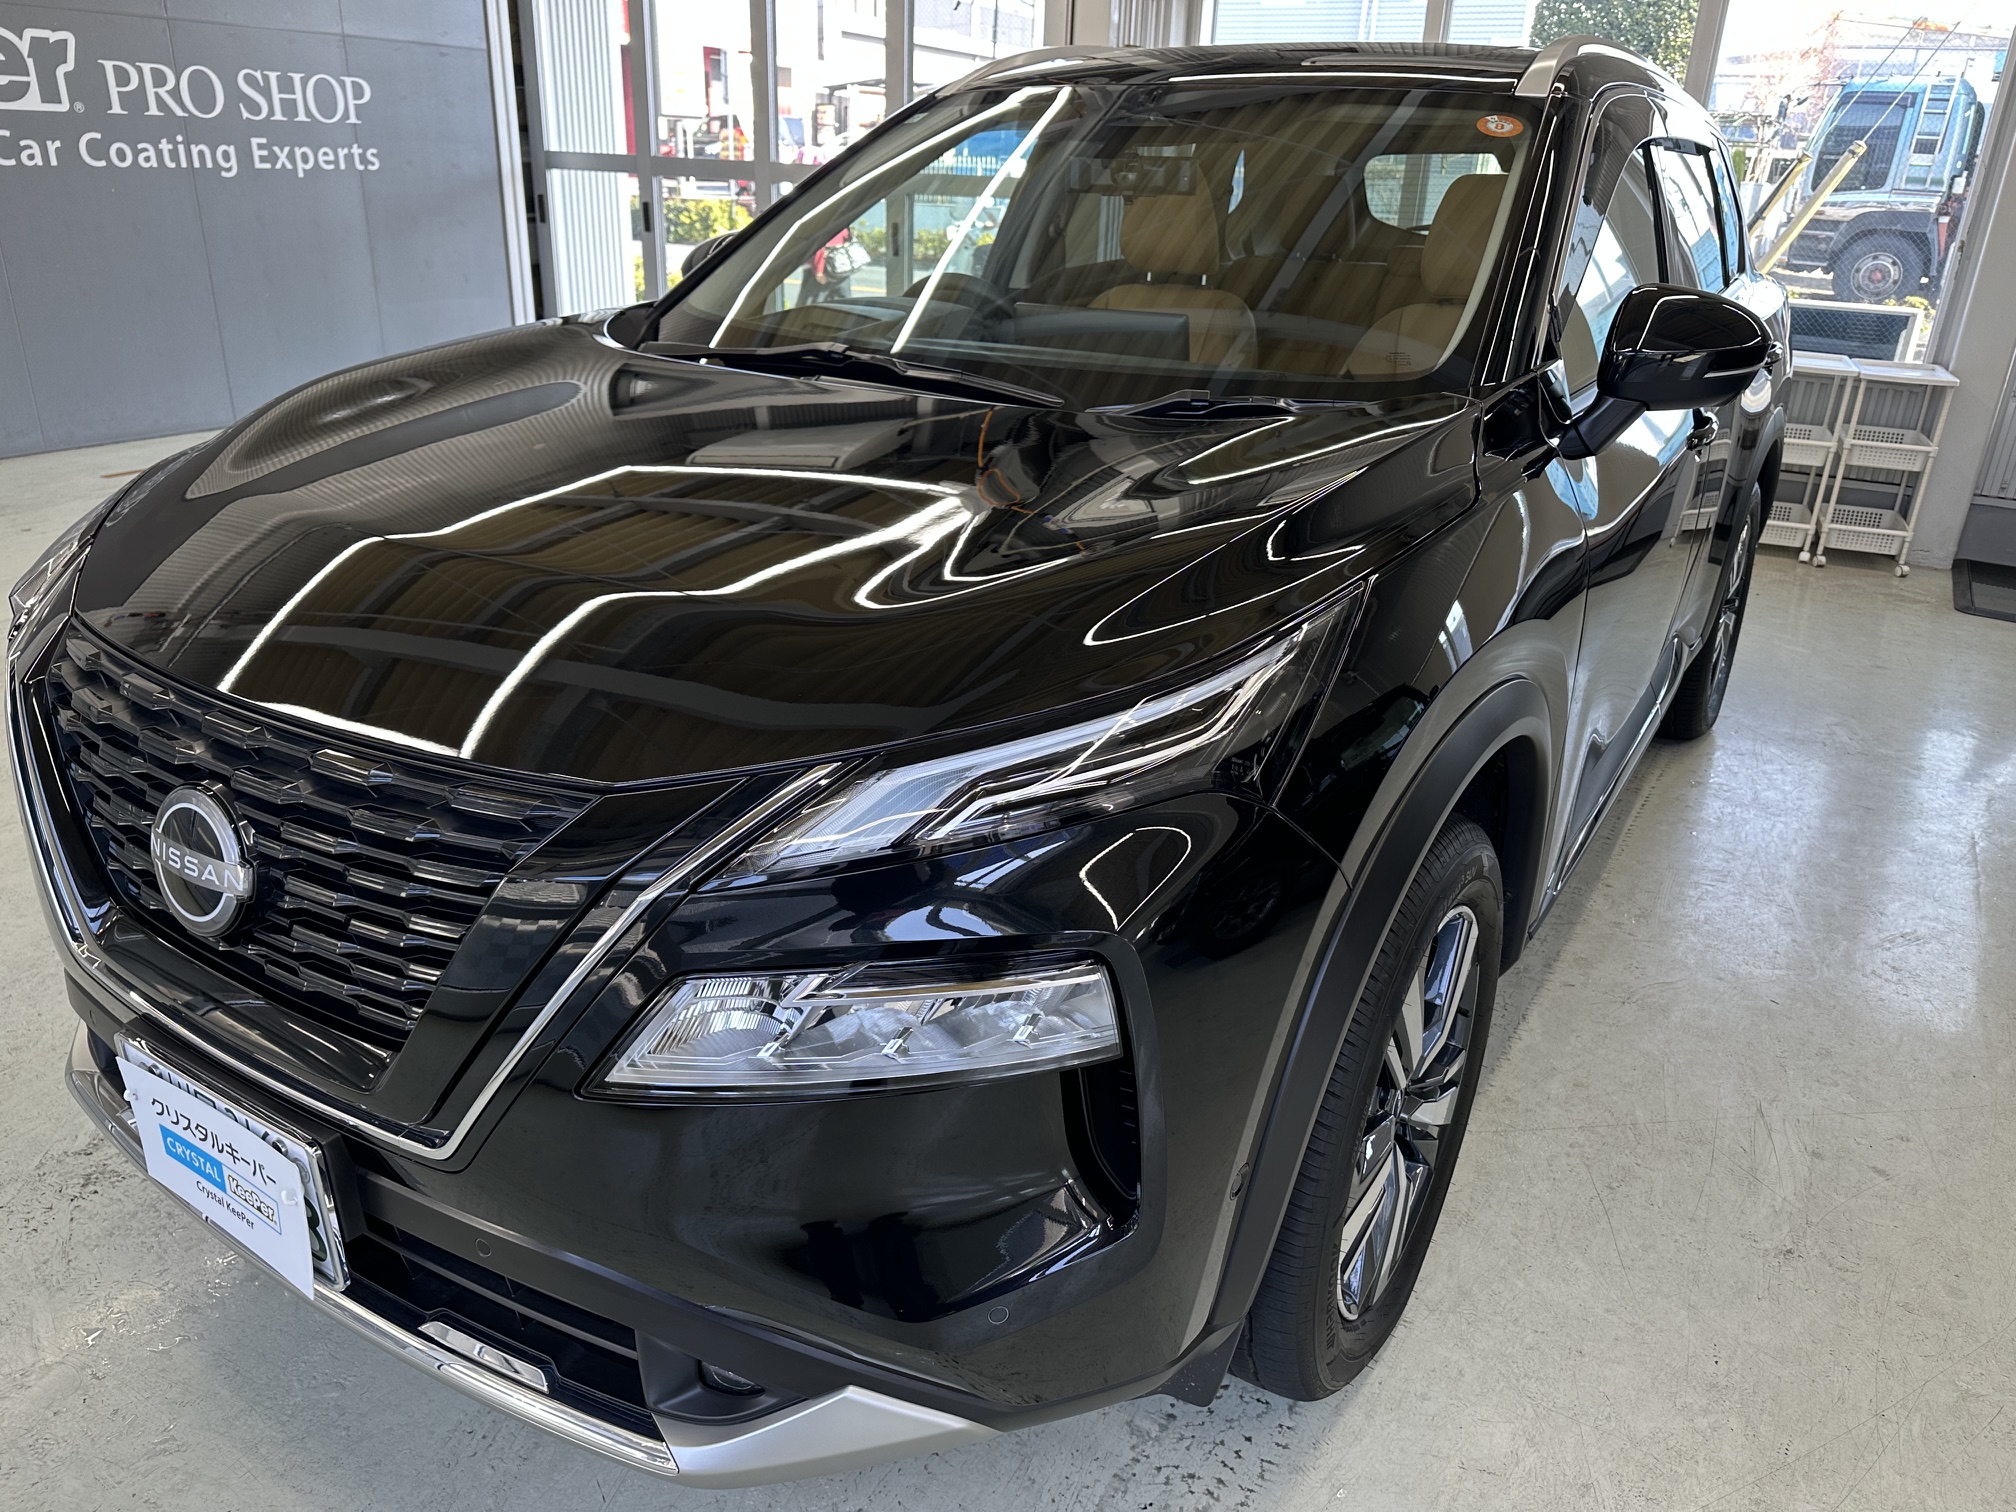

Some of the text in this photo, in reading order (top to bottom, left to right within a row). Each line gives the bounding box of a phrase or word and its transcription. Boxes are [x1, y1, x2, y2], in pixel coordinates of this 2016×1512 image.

[97, 59, 225, 119] PRO
[236, 68, 372, 124] SHOP
[0, 129, 380, 179] Car Coating Experts
[150, 832, 244, 892] NISSAN
[151, 1098, 276, 1186] クリスタルキーパー
[166, 1136, 275, 1222] CRYSTAL KeePer
[196, 1180, 255, 1230] Crystal KeePer
